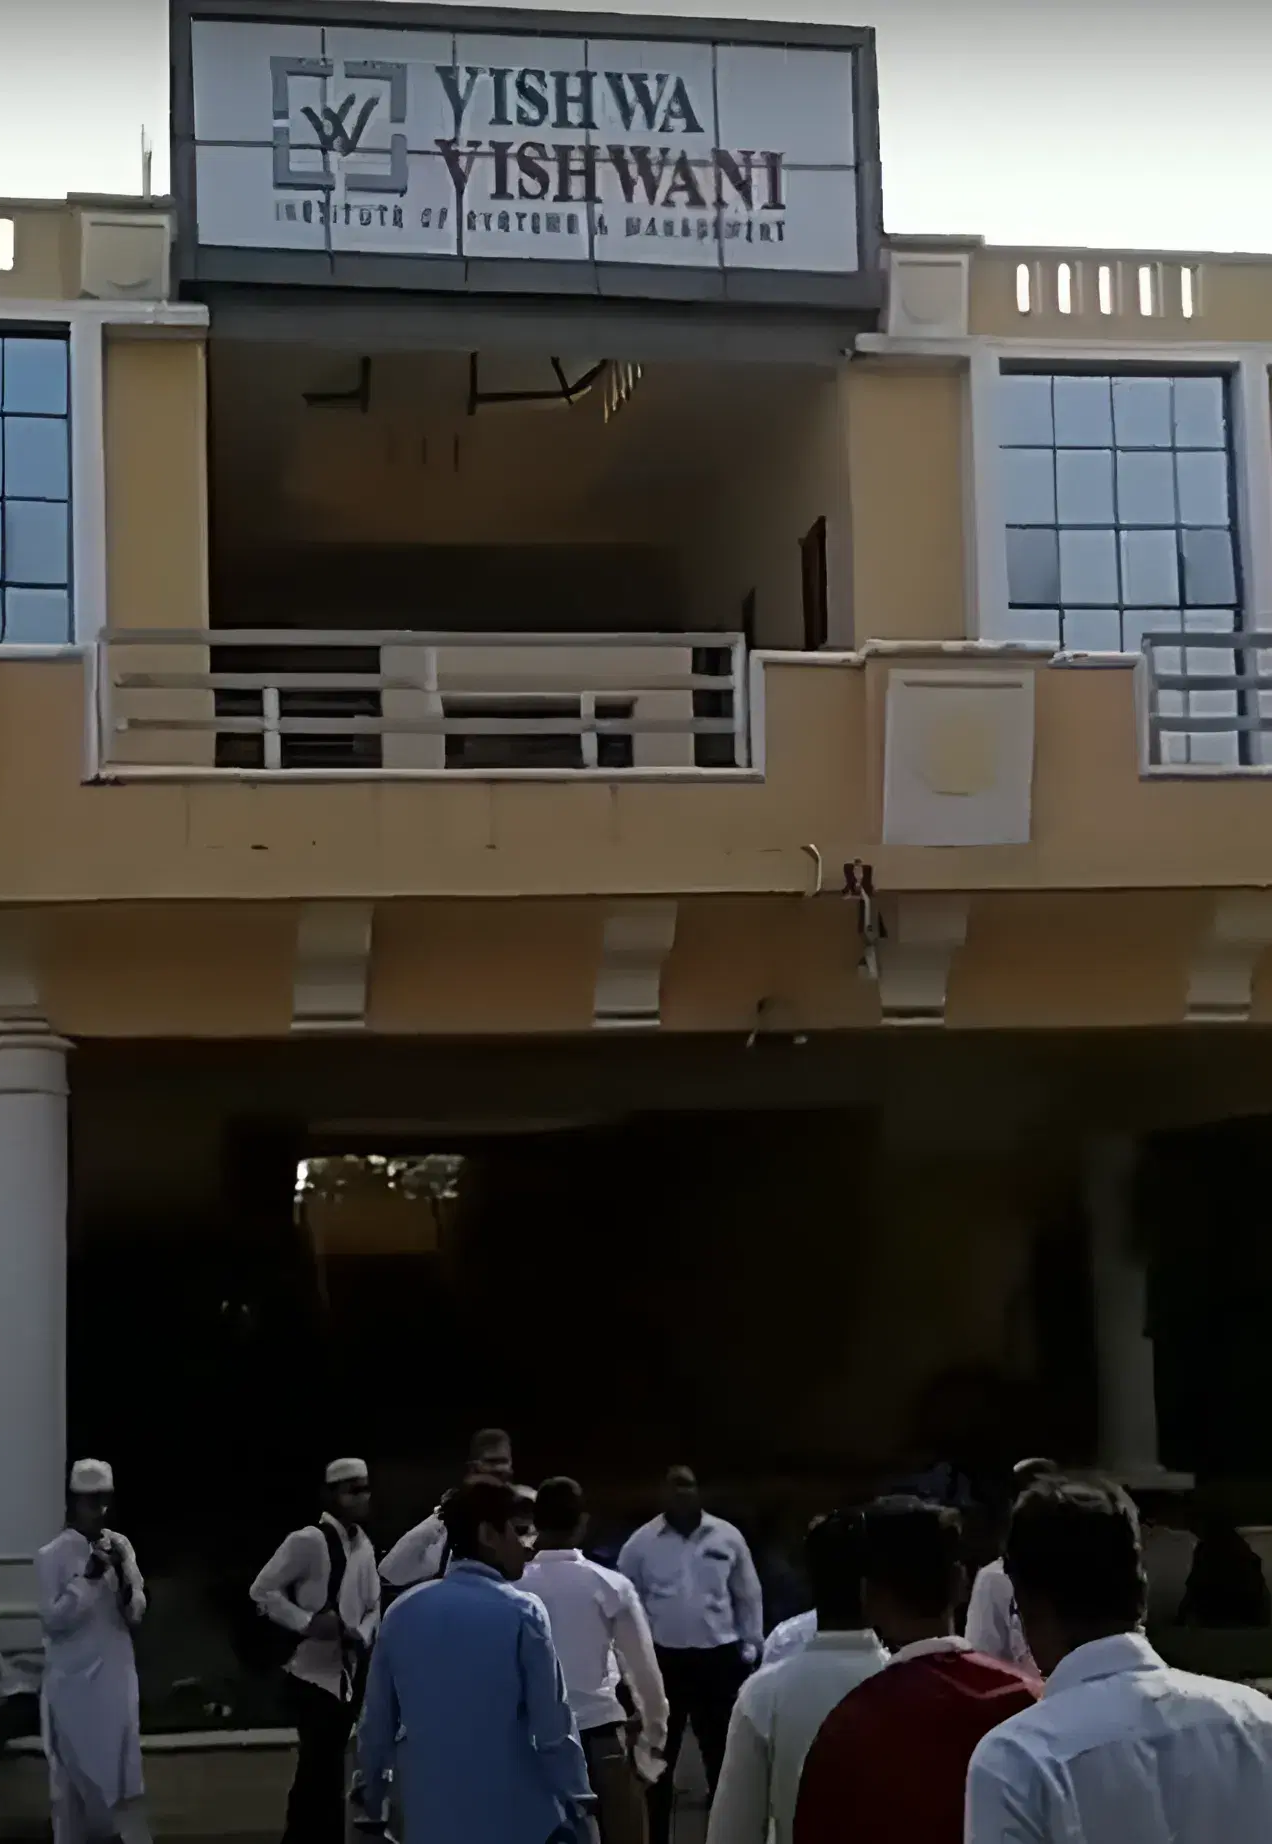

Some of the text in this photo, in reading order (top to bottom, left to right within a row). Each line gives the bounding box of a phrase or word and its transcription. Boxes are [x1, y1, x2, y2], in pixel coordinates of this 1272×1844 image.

[435, 65, 705, 133] VISHWA
[434, 138, 787, 210] VISHWANI
[274, 200, 403, 228] ITITUT
